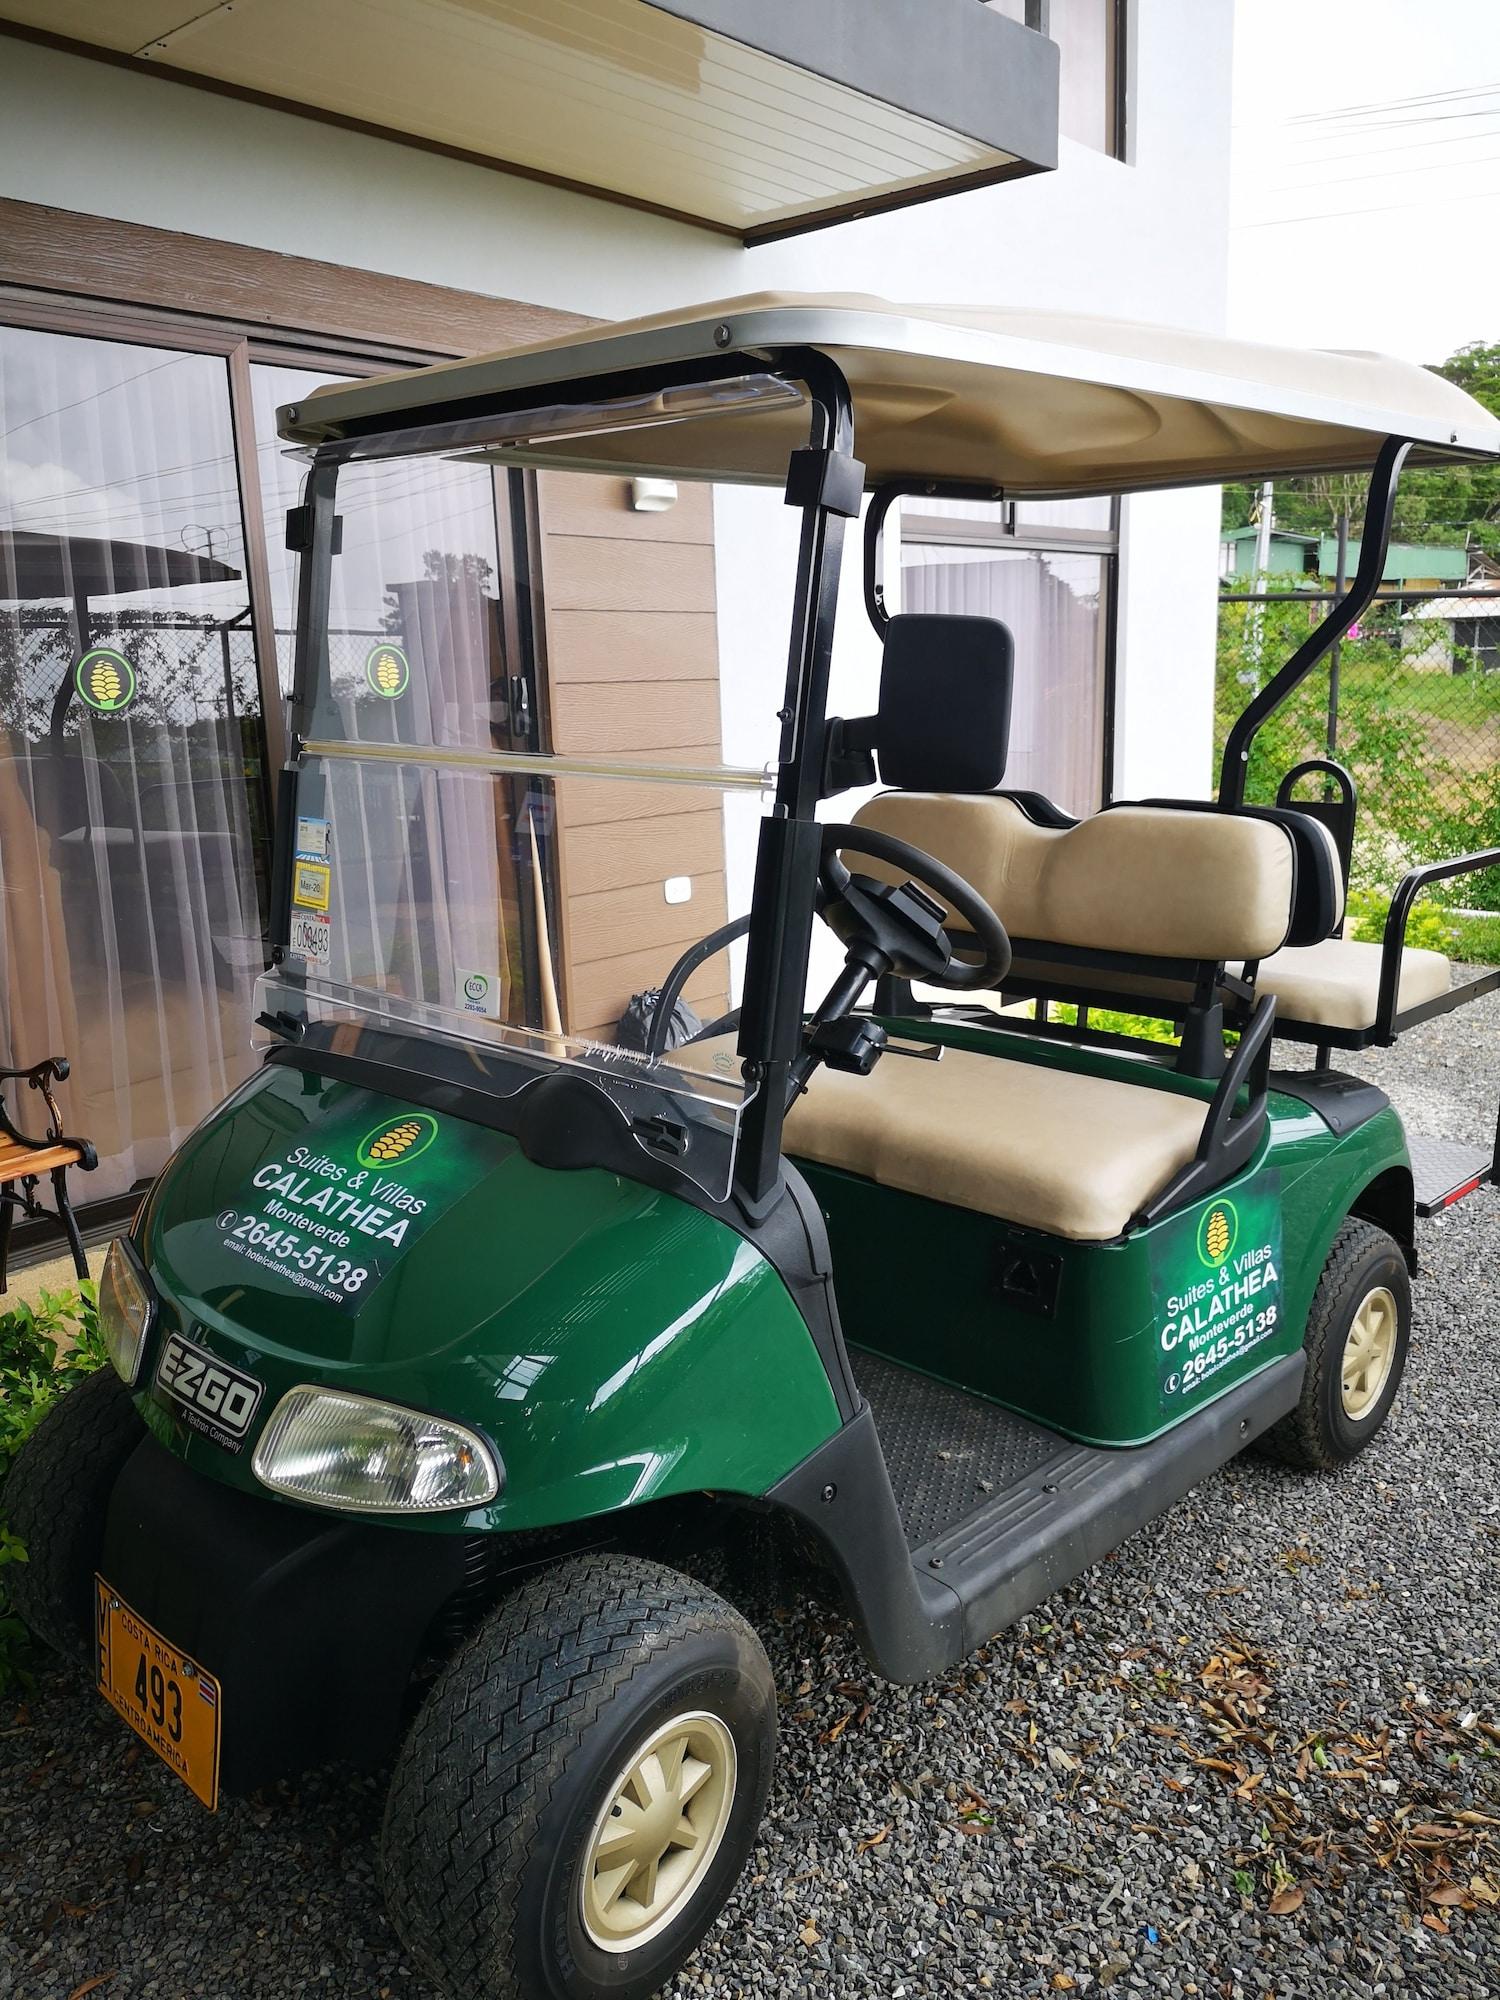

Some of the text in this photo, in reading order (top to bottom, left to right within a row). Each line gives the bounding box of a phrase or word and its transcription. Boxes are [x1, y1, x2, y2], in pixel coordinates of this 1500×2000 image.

[300, 879, 321, 893] Mar-20
[252, 1164, 411, 1248] CALATHEA
[287, 1147, 427, 1215] Suites & Villas
[232, 1216, 368, 1293] 2645-5138
[263, 1199, 350, 1248] Monteverde
[223, 1238, 344, 1304] email: hotelcalathea@gmail.com
[1161, 1262, 1278, 1351] CALATHEA
[1167, 1244, 1272, 1318] Suites & Villas
[1182, 1305, 1277, 1384] 2645-5138
[1188, 1302, 1254, 1352] Monteverde
[159, 1342, 256, 1428] EZGO
[182, 1409, 242, 1454] A Textron Company
[121, 1613, 178, 1676] COSTA RICA
[113, 1690, 190, 1776] CENTROAMERICA
[135, 1653, 183, 1743] 493
